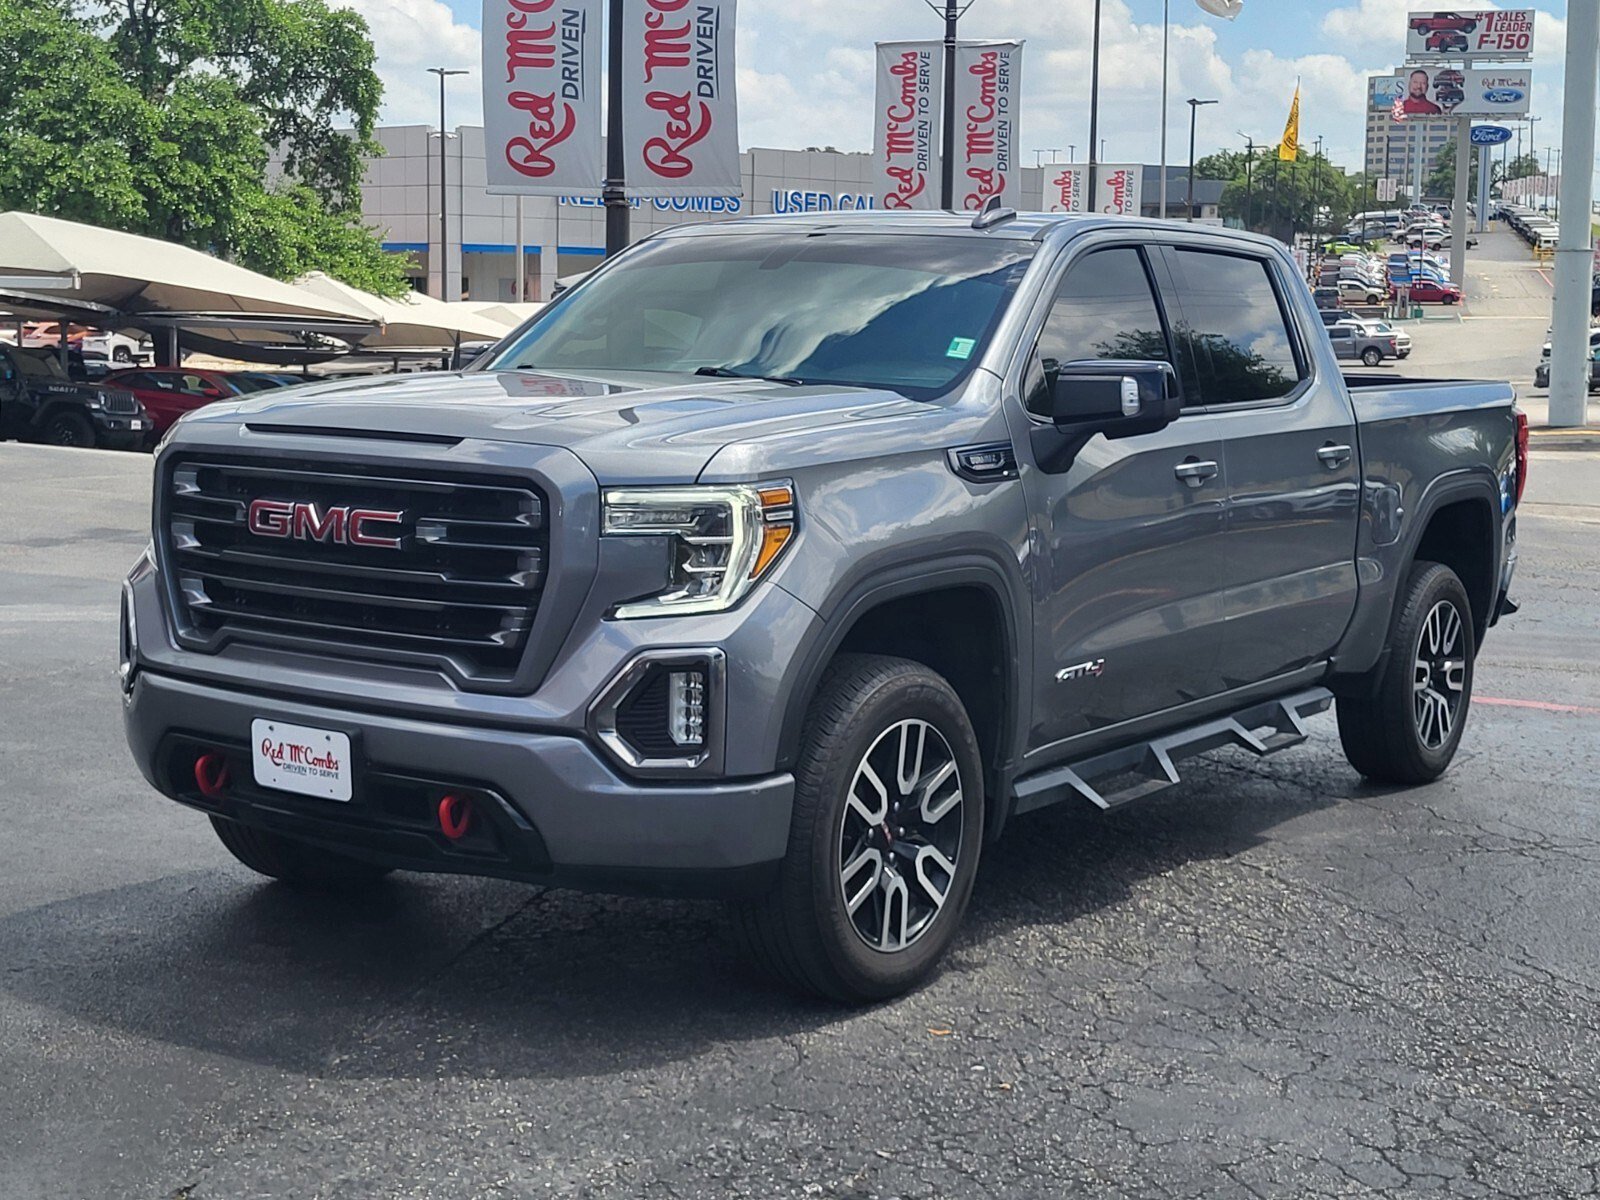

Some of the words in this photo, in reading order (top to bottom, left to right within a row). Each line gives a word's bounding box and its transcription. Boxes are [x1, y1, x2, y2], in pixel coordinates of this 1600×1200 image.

[1475, 12, 1495, 32] #1
[1496, 12, 1526, 21] SALES
[1494, 22, 1532, 32] LEADER
[561, 9, 580, 100] DRIVEN
[696, 6, 714, 98] DRIVEN
[1477, 33, 1530, 50] F-150
[919, 51, 931, 93] SERVE
[999, 51, 1010, 93] SERVE
[886, 51, 918, 162] McCombs
[918, 97, 930, 115] TO
[966, 51, 998, 163] McCombs
[998, 97, 1009, 115] TO
[1490, 91, 1517, 102] Ford
[506, 91, 576, 178] Red
[643, 91, 712, 178] Red
[917, 120, 929, 172] DRIVEN
[997, 121, 1008, 172] DRIVEN
[1472, 128, 1503, 141] Ford
[1072, 170, 1081, 198] SERVE
[1126, 170, 1134, 198] SERVE
[773, 190, 832, 214] USED
[1072, 200, 1080, 212] TO
[1125, 200, 1134, 212] TO
[249, 499, 403, 550] GMC
[262, 738, 284, 766] Red
[286, 743, 339, 770] McCombs
[283, 763, 307, 774] DRIVEN
[309, 767, 317, 776] TO
[319, 769, 340, 779] SERVE
